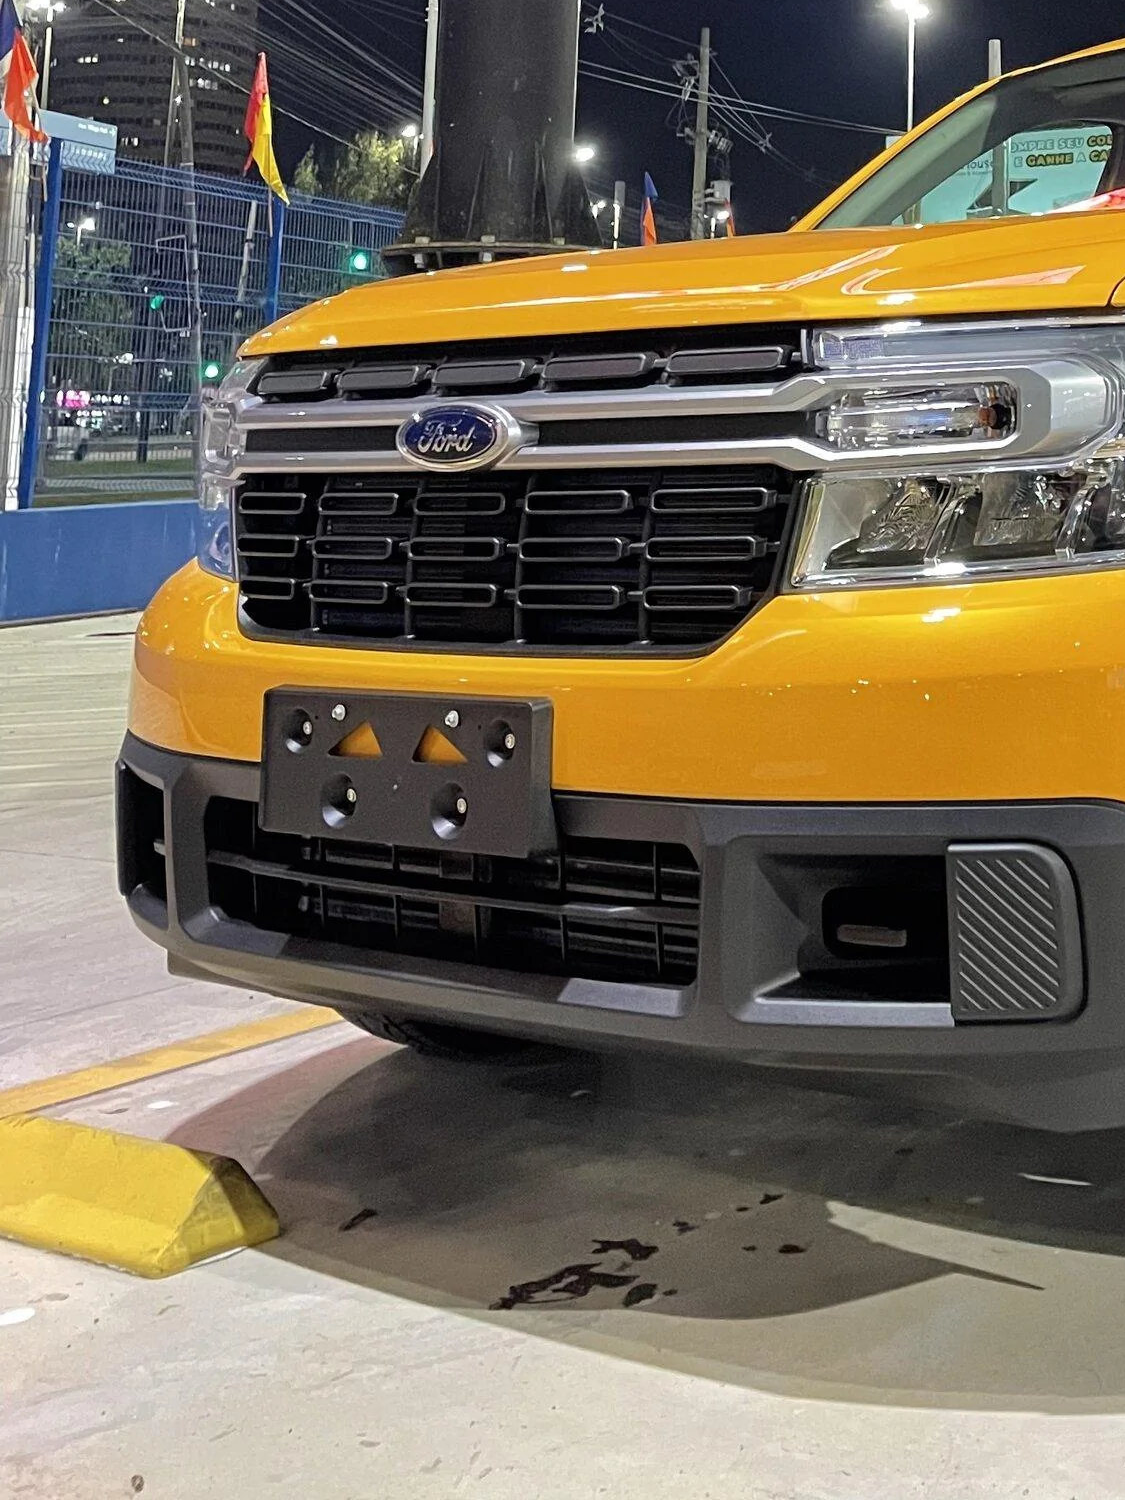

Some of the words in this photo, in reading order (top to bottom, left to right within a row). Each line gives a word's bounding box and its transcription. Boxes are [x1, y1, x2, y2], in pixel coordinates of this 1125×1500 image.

[1057, 137, 1084, 150] SEU
[1014, 156, 1023, 167] E
[1026, 153, 1073, 167] GANHE
[1076, 152, 1087, 162] A
[417, 419, 476, 453] Ford
